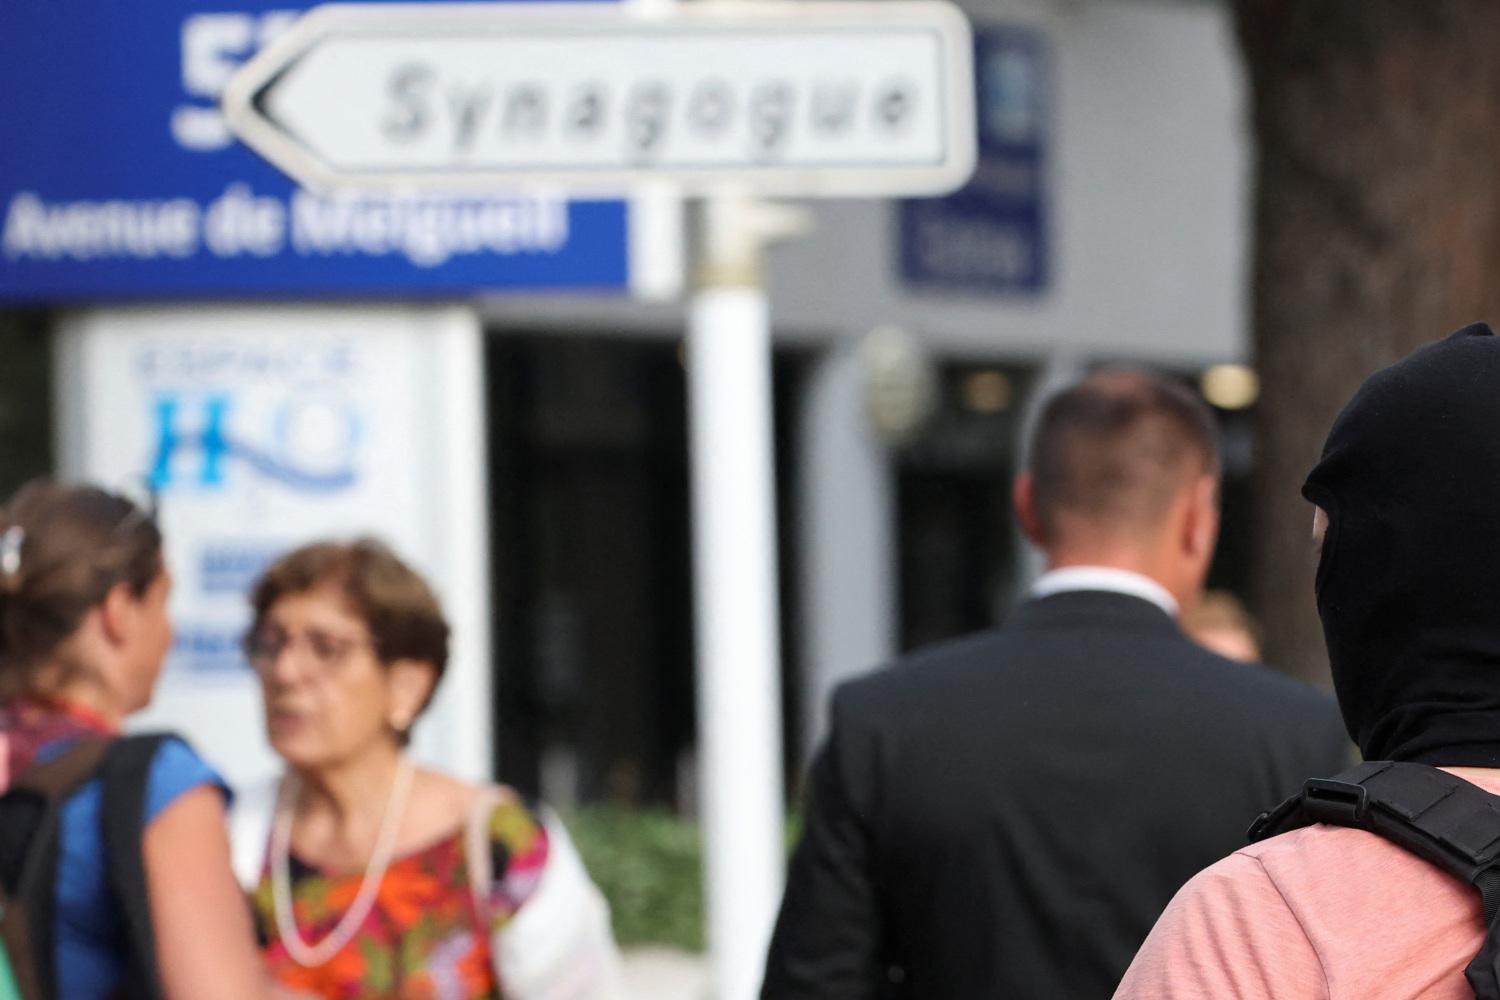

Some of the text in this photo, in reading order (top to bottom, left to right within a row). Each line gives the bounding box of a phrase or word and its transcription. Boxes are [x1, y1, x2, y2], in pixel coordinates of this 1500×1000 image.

[380, 60, 920, 167] Synagogue
[5, 196, 198, 257] Avenue
[204, 184, 285, 257] de
